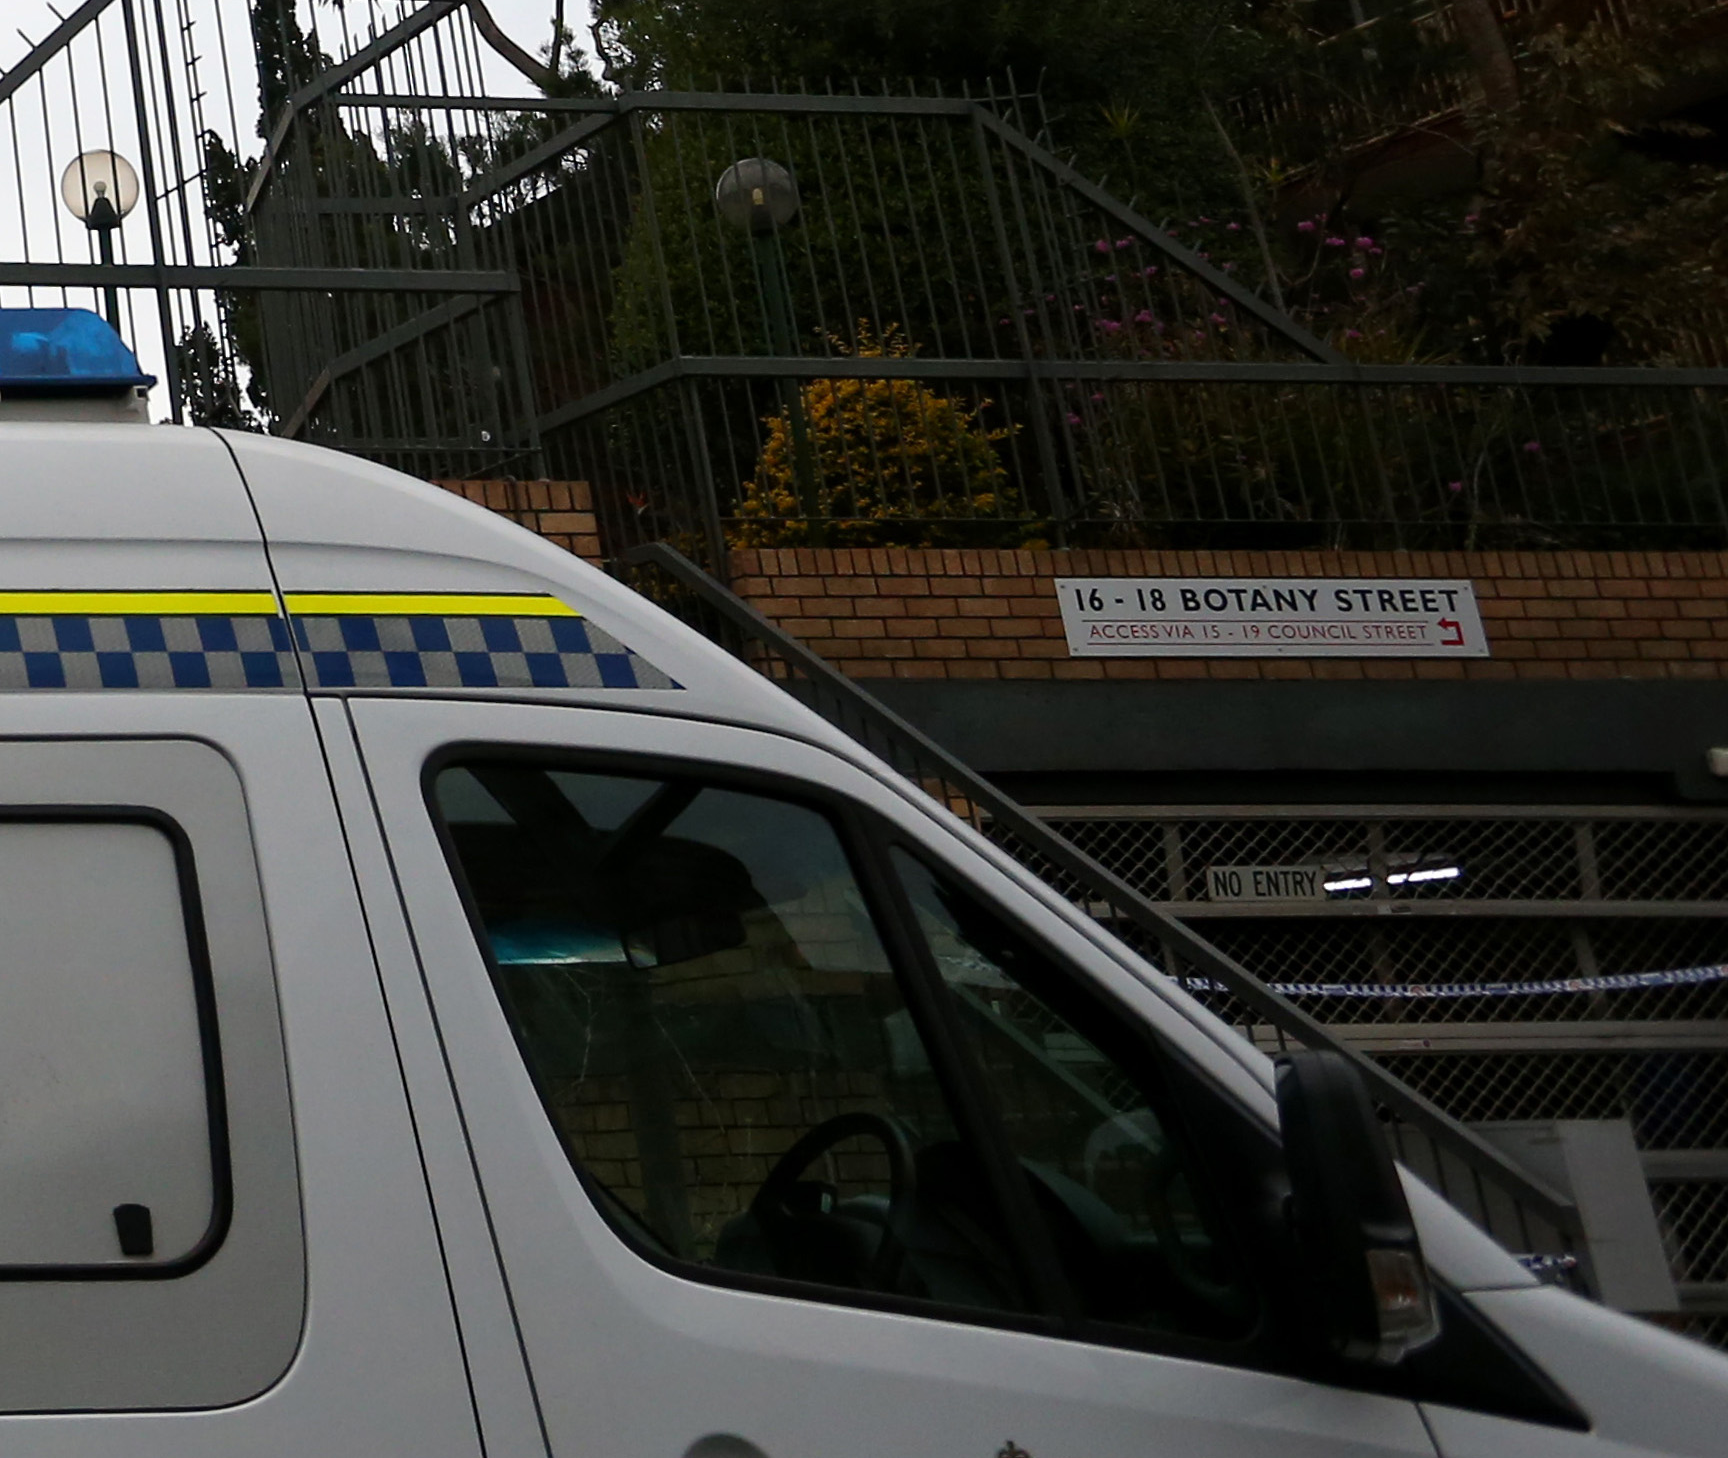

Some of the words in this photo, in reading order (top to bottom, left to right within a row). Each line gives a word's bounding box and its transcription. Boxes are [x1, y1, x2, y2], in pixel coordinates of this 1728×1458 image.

[1075, 588, 1104, 612] 16
[1137, 588, 1166, 612] 18
[1179, 588, 1318, 612] BOTANY
[1334, 589, 1458, 612] STREET
[1090, 624, 1160, 639] ACCESS
[1164, 624, 1194, 639] VIA
[1202, 625, 1220, 639] 15
[1243, 624, 1260, 639] 19
[1267, 624, 1356, 639] COUNCIL
[1362, 624, 1426, 639] STREET
[1213, 871, 1243, 896] NO
[1253, 871, 1317, 896] ENTRY
